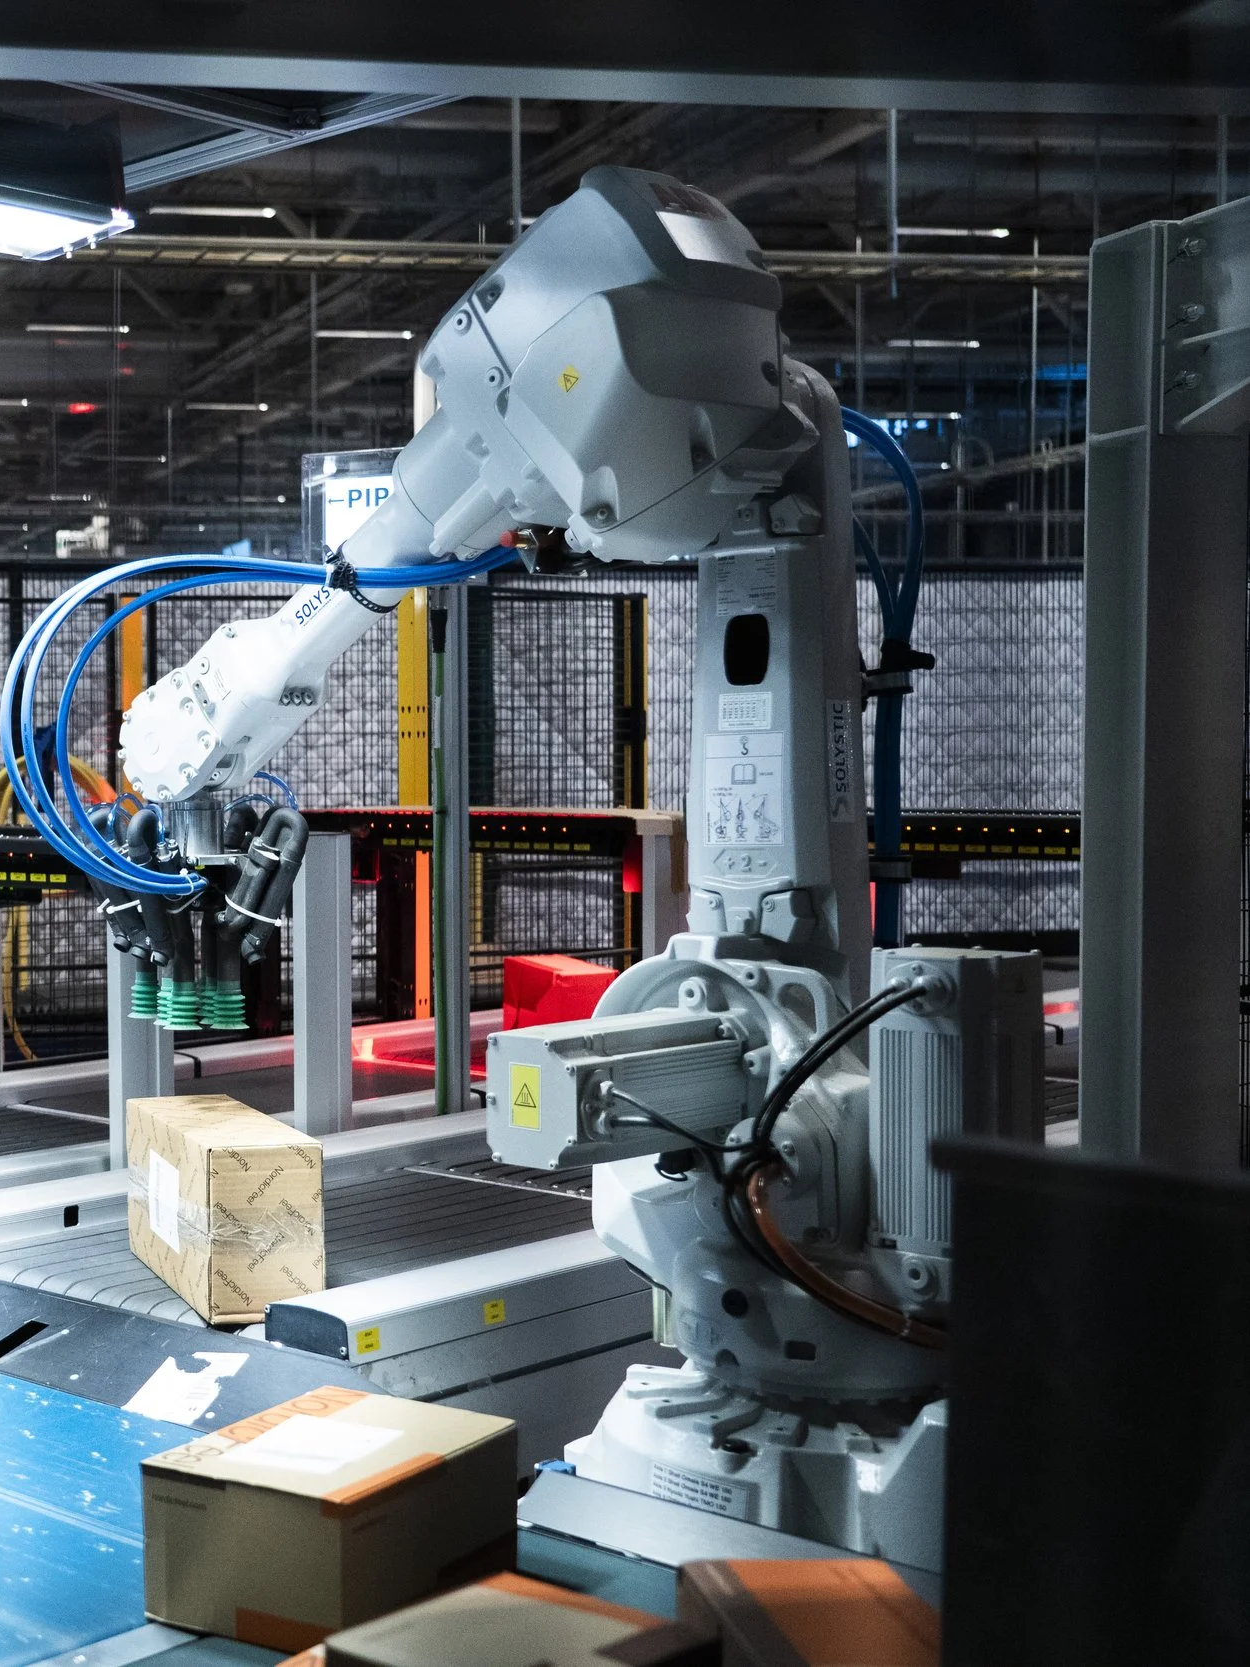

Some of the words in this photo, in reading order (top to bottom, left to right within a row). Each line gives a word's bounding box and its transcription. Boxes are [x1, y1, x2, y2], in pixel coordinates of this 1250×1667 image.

[295, 585, 330, 625] SOLYS
[833, 703, 847, 793] SOLYSTIC
[246, 1165, 284, 1206] NordicFeel
[214, 1268, 253, 1306] NordicFeel
